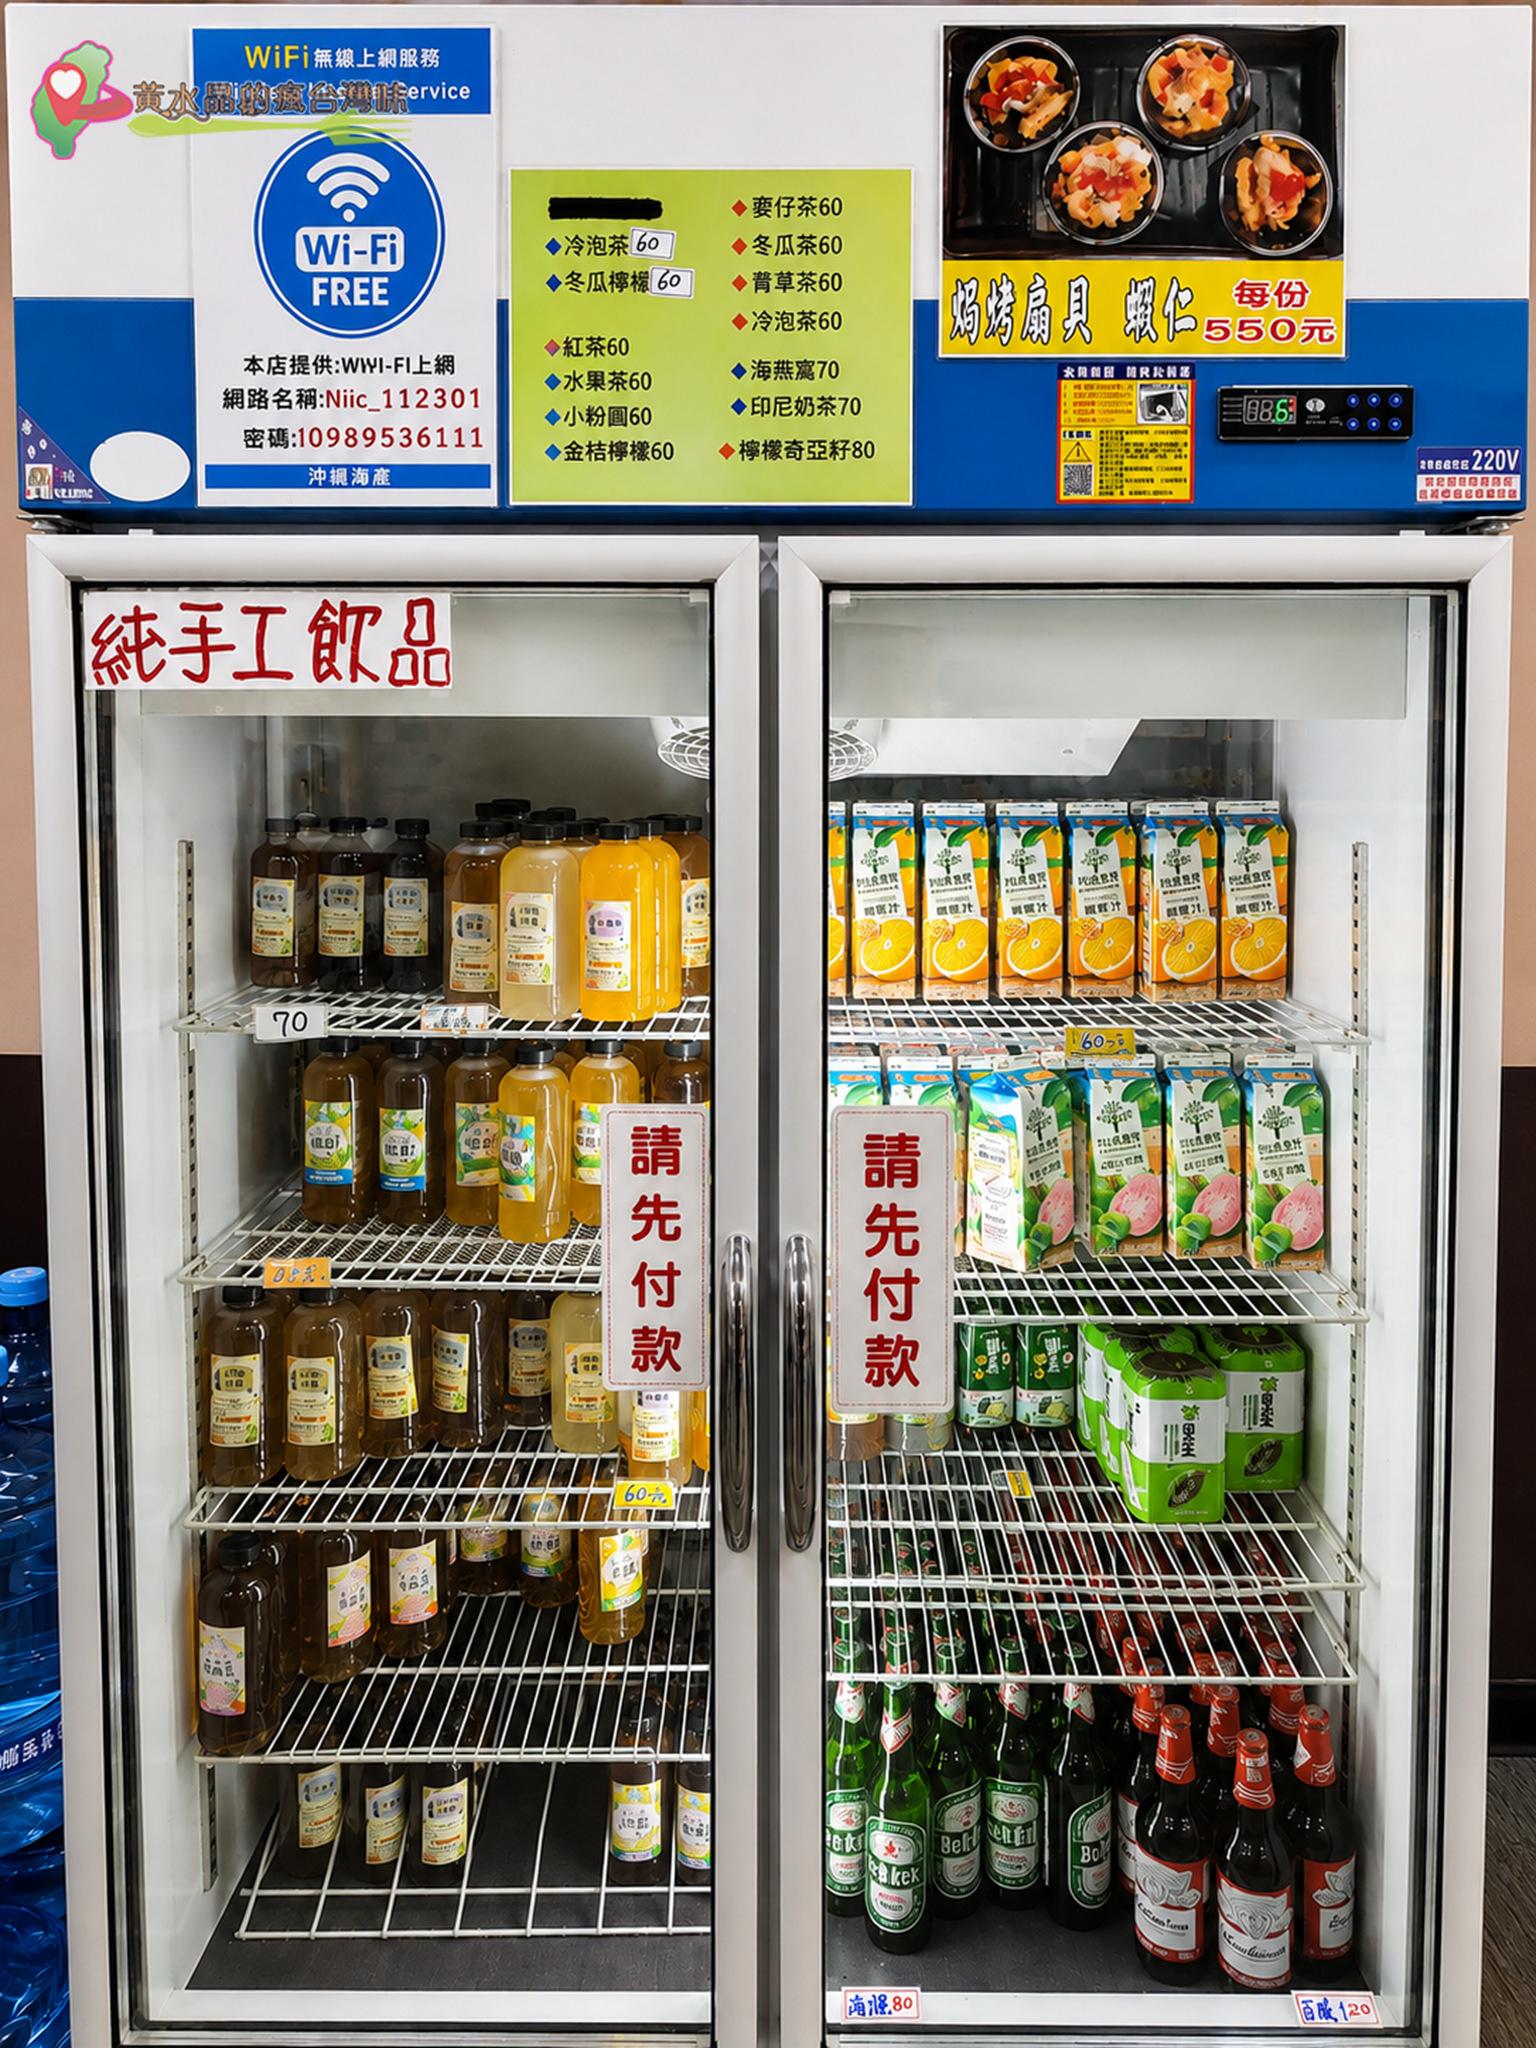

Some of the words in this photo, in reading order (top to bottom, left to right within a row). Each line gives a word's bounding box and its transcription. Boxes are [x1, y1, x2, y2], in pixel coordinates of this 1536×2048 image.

[244, 45, 309, 69] WiFi
[302, 233, 399, 266] Wi-Fi
[564, 234, 629, 256] 冷泡茶
[636, 231, 659, 252] 60
[752, 233, 843, 256] 冬瓜茶60
[312, 276, 389, 307] FREE
[657, 269, 681, 291] 60
[1233, 278, 1310, 309] 每份
[752, 310, 843, 332] 冷泡茶60
[1203, 318, 1335, 344] 550元
[562, 336, 630, 358] 紅茶60
[563, 370, 652, 392] 水果茶60
[750, 395, 862, 418] 印尼奶茶70
[1472, 449, 1520, 471] 220V
[91, 597, 451, 687] 純手工飲品
[272, 1011, 308, 1037] 70
[631, 1124, 682, 1373] 請先付款
[863, 1132, 921, 1388] 請先付款
